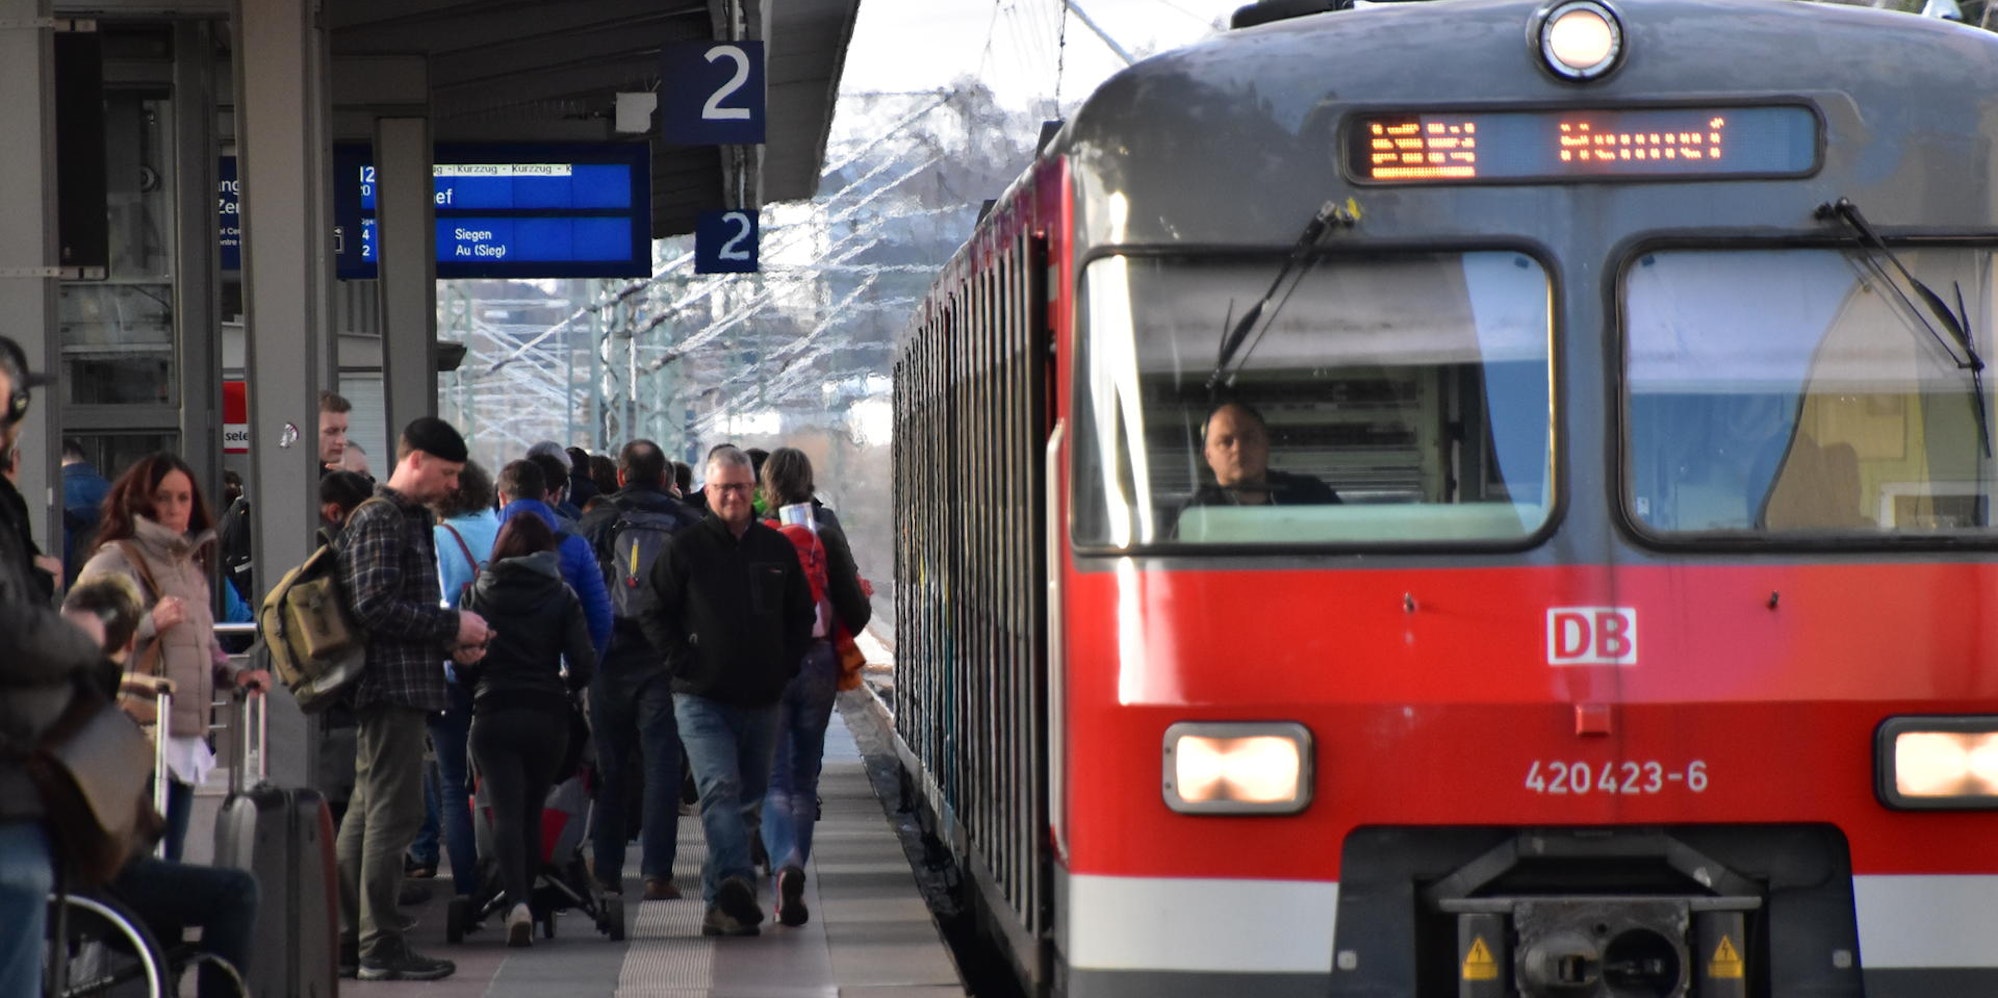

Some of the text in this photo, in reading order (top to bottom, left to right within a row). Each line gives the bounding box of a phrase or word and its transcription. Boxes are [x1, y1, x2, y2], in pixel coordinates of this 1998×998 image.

[702, 45, 750, 119] 2
[1560, 117, 1724, 161] Hennef
[457, 164, 498, 174] Kurzzug
[512, 164, 552, 174] Kurzzug
[454, 228, 492, 241] Siegen
[455, 244, 471, 256] Au
[474, 244, 506, 258] (Sieg)
[719, 212, 751, 260] 2
[1553, 611, 1633, 660] DB
